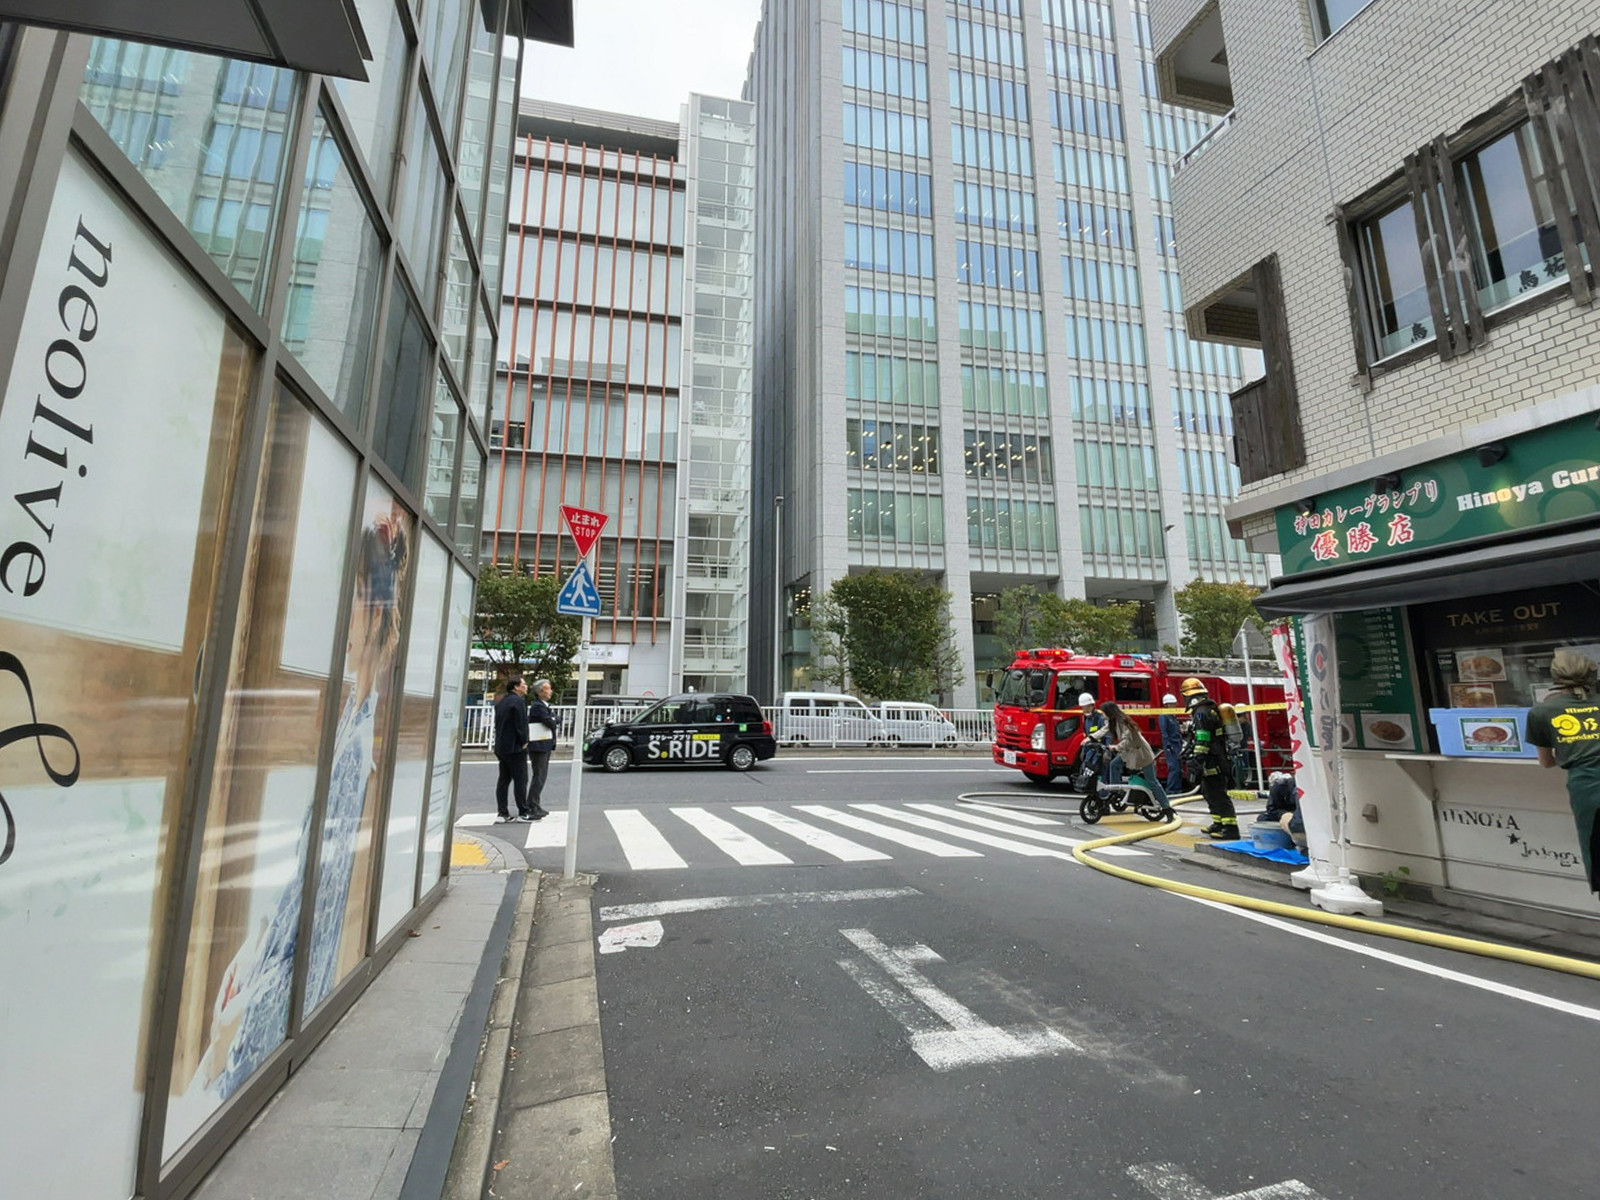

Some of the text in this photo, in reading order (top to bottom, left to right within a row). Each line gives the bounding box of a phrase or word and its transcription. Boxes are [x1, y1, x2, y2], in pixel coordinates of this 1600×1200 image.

[0, 213, 113, 599] neolive
[1293, 479, 1439, 536] 神田カレーグランプリ
[1456, 465, 1600, 511] Hinoya Cur
[570, 511, 601, 527] 止まれ
[574, 525, 597, 538] STOP
[1311, 513, 1415, 560] 優勝店
[1446, 602, 1562, 628] TAKE OUT
